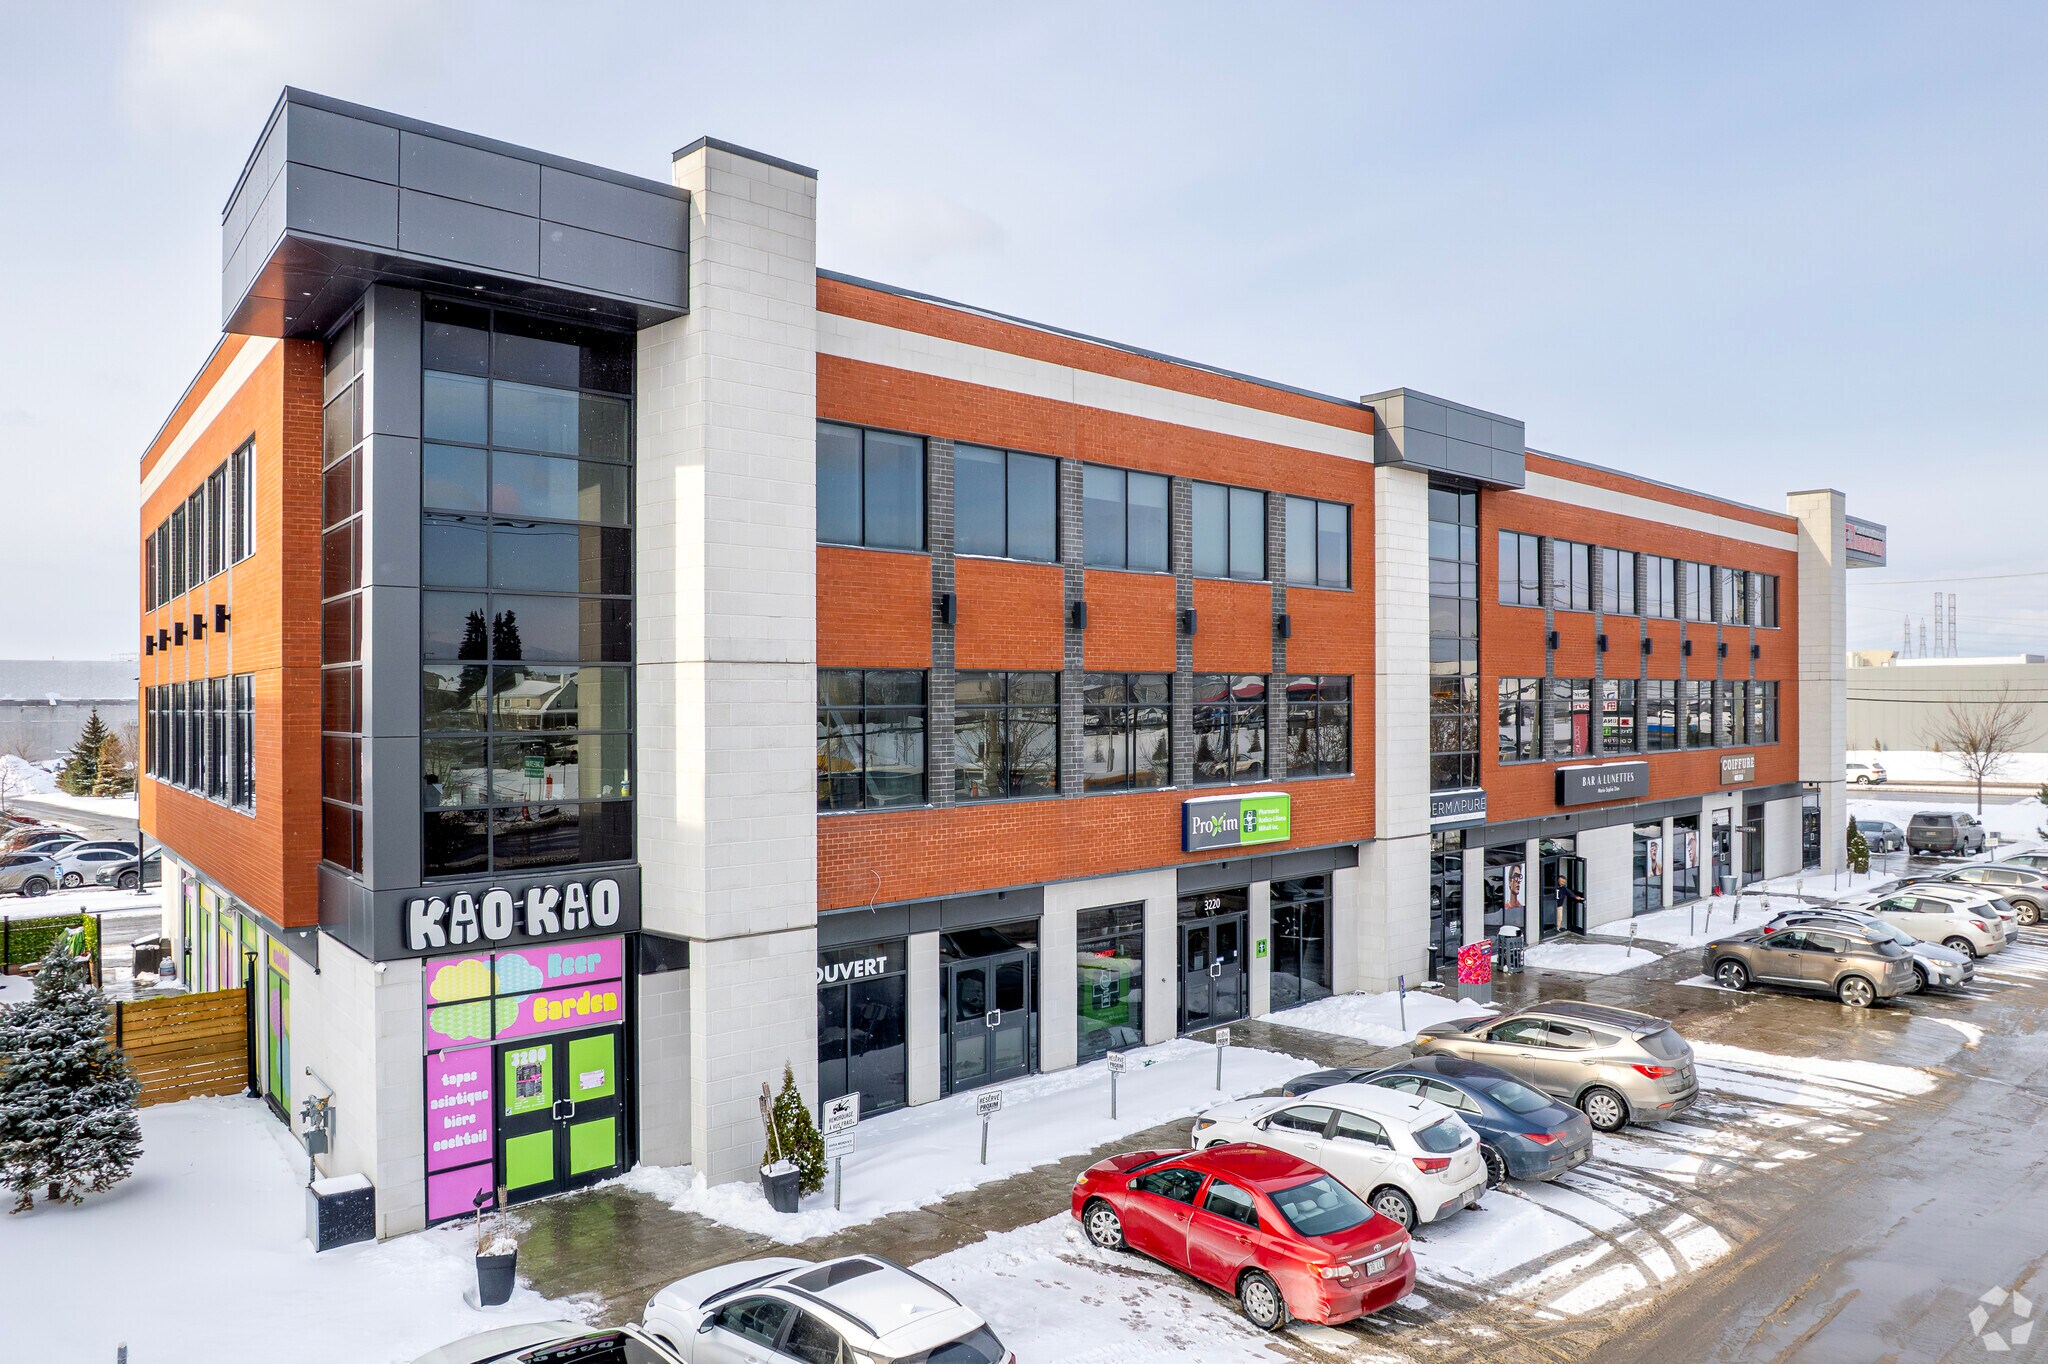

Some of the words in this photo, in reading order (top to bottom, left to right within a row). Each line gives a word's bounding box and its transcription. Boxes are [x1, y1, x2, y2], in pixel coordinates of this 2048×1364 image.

[1722, 757, 1755, 771] COIFFURE
[1582, 776, 1596, 786] BAR
[1597, 774, 1602, 785] À
[1603, 772, 1634, 785] LUNETTES
[1192, 812, 1239, 837] Proxim
[1204, 898, 1220, 910] 3220
[409, 889, 514, 950] KAO
[525, 879, 621, 937] KAO
[547, 953, 602, 979] Beer
[533, 990, 618, 1023] Garden
[511, 1048, 546, 1066] 3200
[442, 1071, 478, 1088] tapas
[430, 1090, 488, 1110] asiatique
[980, 1102, 998, 1110] PROXIM
[444, 1114, 476, 1128] bière
[434, 1128, 488, 1152] cocktail
